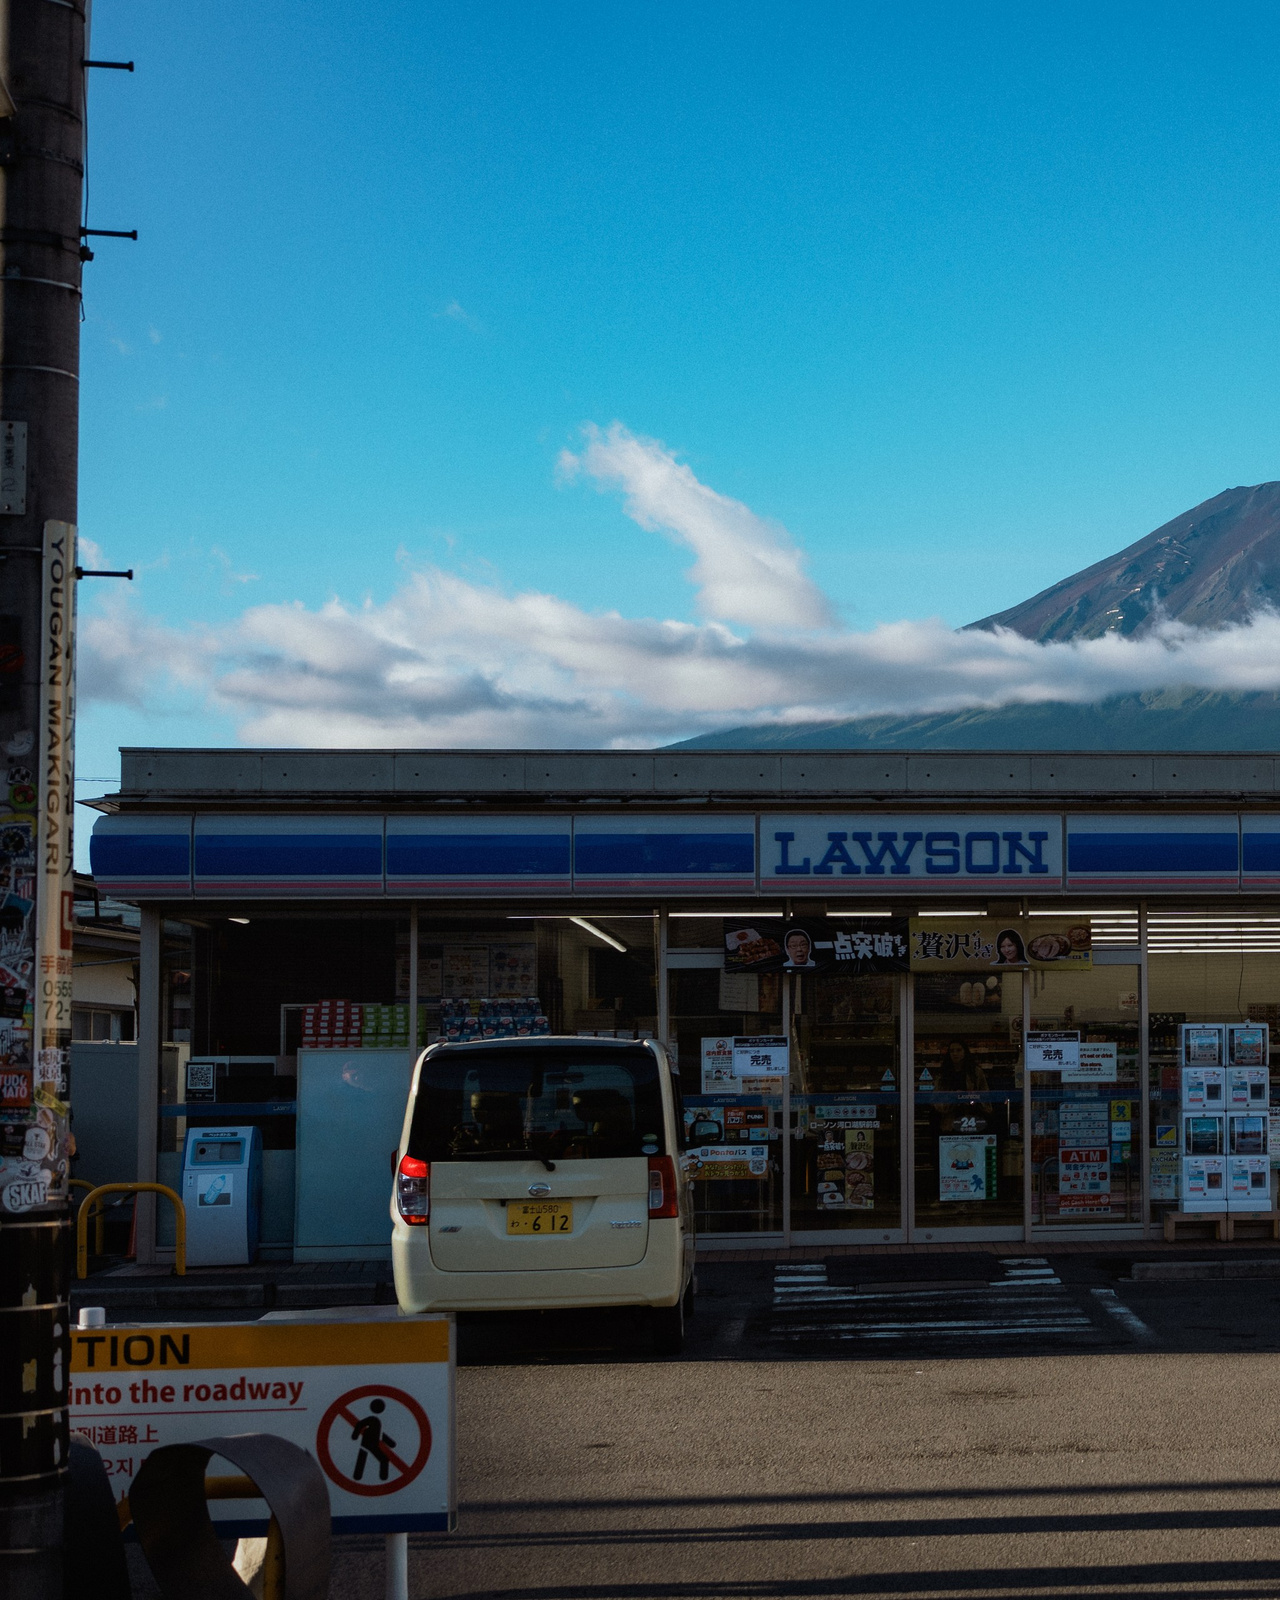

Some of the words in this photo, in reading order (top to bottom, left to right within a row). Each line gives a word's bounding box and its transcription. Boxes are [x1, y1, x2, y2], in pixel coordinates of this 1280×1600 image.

[49, 536, 65, 687] YOUGAN
[46, 699, 62, 875] MAKIGARI
[774, 832, 1046, 874] LAWSON
[43, 1001, 72, 1021] 72-
[750, 1055, 772, 1066] 完売
[1042, 1049, 1063, 1060] 完売
[960, 1117, 976, 1128] 24
[1069, 1150, 1100, 1162] ATM
[1065, 1163, 1104, 1171] 現金チャージ
[69, 1334, 190, 1367] TION
[68, 1383, 122, 1405] into
[129, 1379, 175, 1403] the
[183, 1376, 304, 1405] roadway
[70, 1424, 159, 1445] 到道路上
